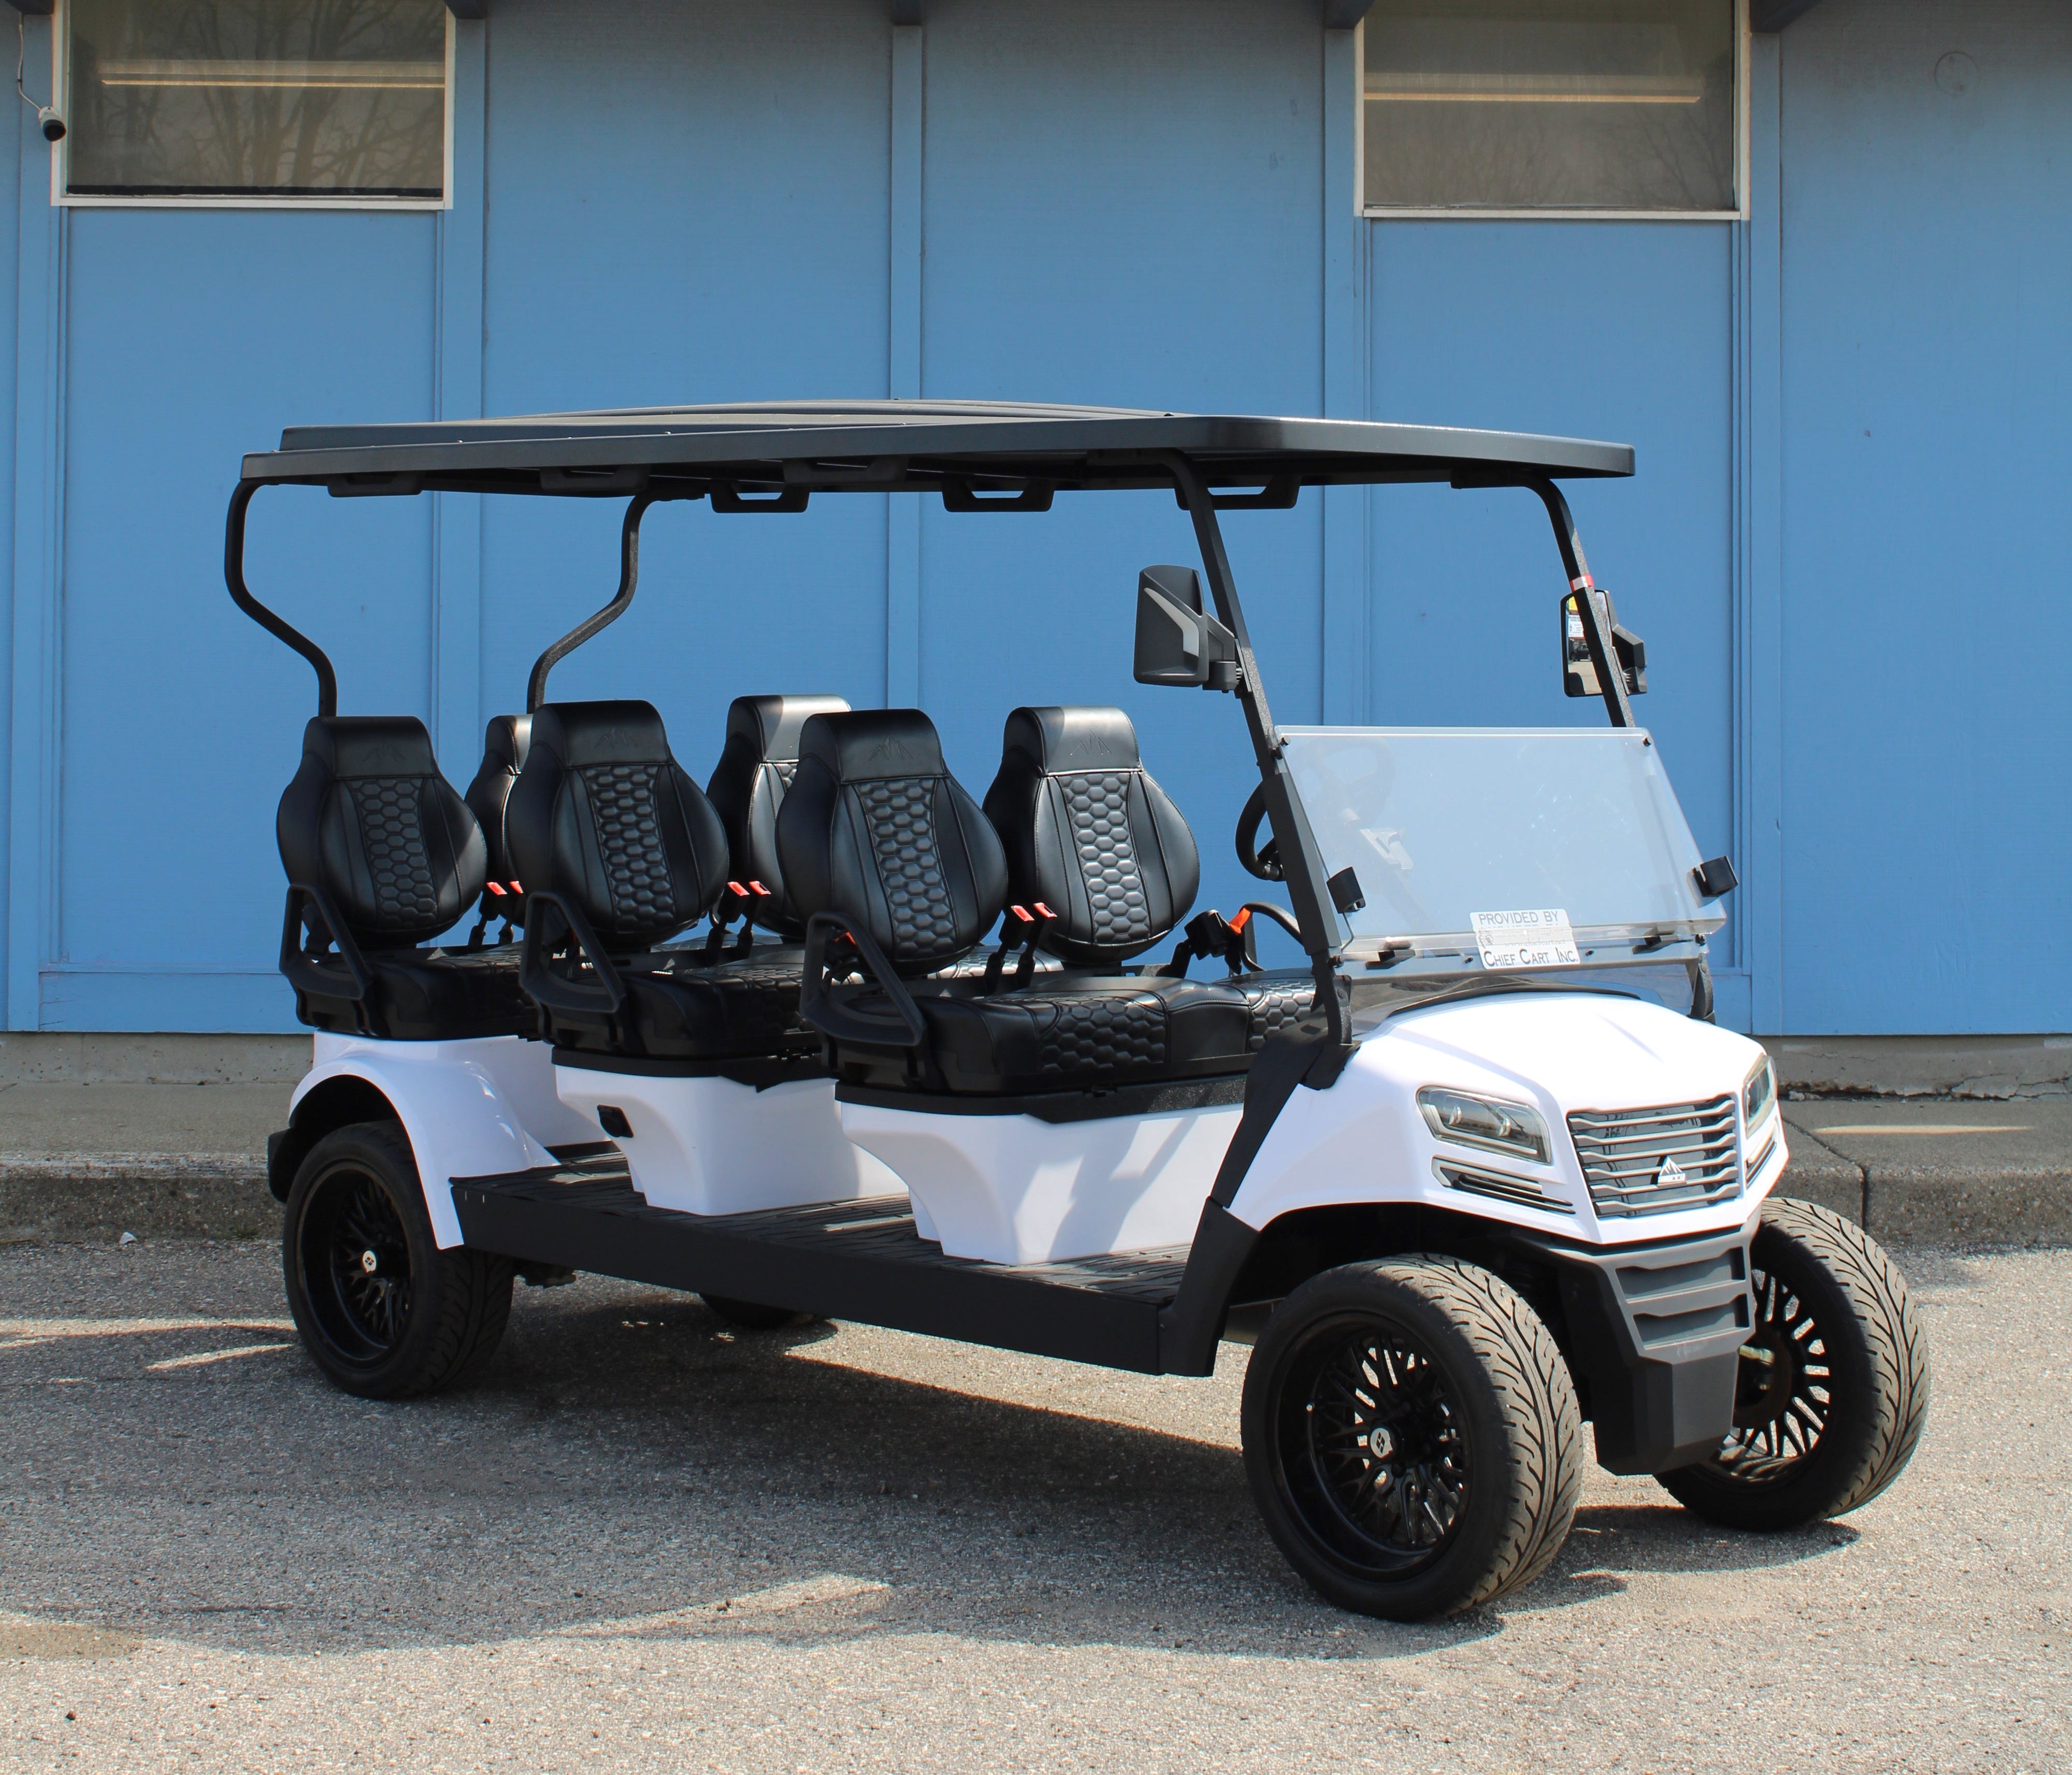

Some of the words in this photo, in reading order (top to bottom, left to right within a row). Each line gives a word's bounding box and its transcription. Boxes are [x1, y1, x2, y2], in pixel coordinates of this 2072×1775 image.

[1478, 911, 1538, 925] PROVIDED
[1543, 911, 1558, 922] BY
[1484, 950, 1516, 966] CHIEF
[1519, 948, 1549, 965] CART
